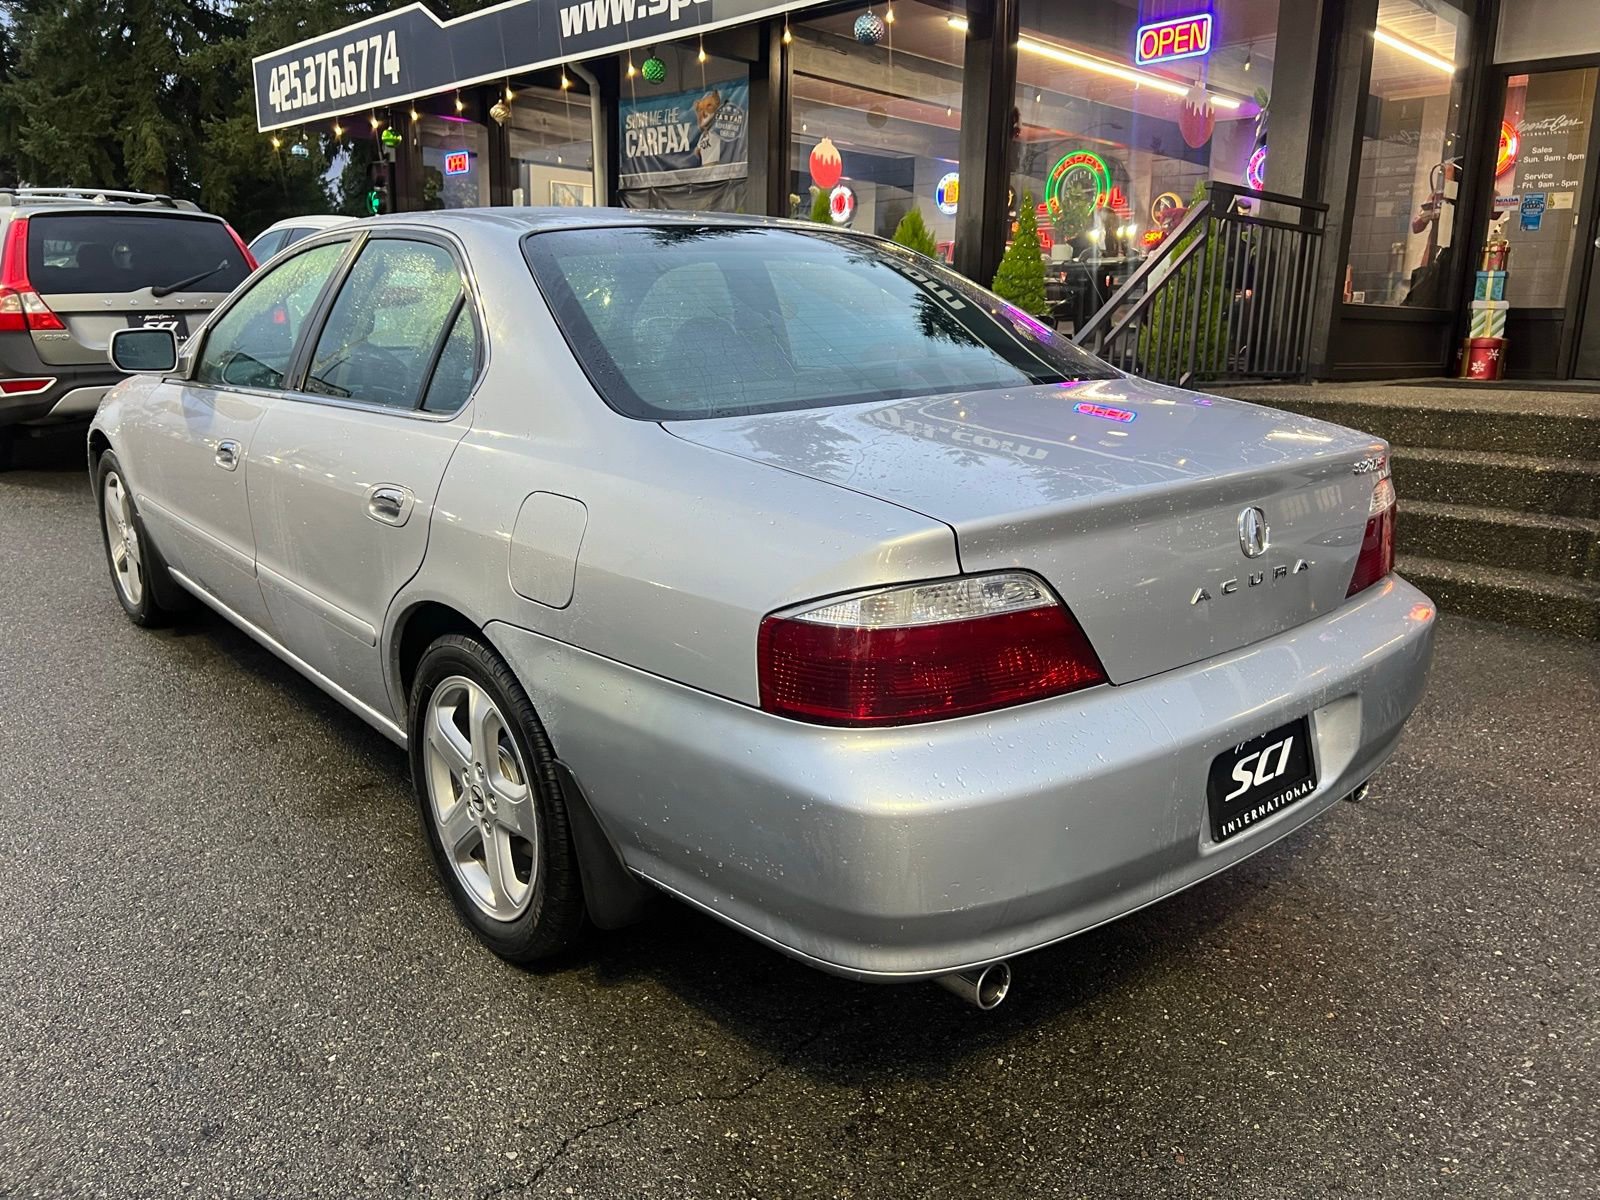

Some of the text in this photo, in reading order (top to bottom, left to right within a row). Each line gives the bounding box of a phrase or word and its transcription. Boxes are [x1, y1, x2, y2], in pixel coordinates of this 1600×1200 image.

[1140, 20, 1207, 59] OPEN
[269, 30, 400, 113] 425.276.6774
[625, 122, 692, 158] CARFAX
[1532, 146, 1553, 154] Sales
[447, 154, 467, 172] OPEN
[1053, 154, 1104, 180] HAPPY
[1523, 155, 1540, 163] Sun.
[1544, 154, 1561, 162] 9am
[1538, 180, 1555, 188] 9am
[1561, 180, 1579, 188] 5pm
[1190, 559, 1309, 605] ACURA
[1225, 736, 1294, 802] SCI
[1222, 779, 1315, 837] INTERNATIONAL
